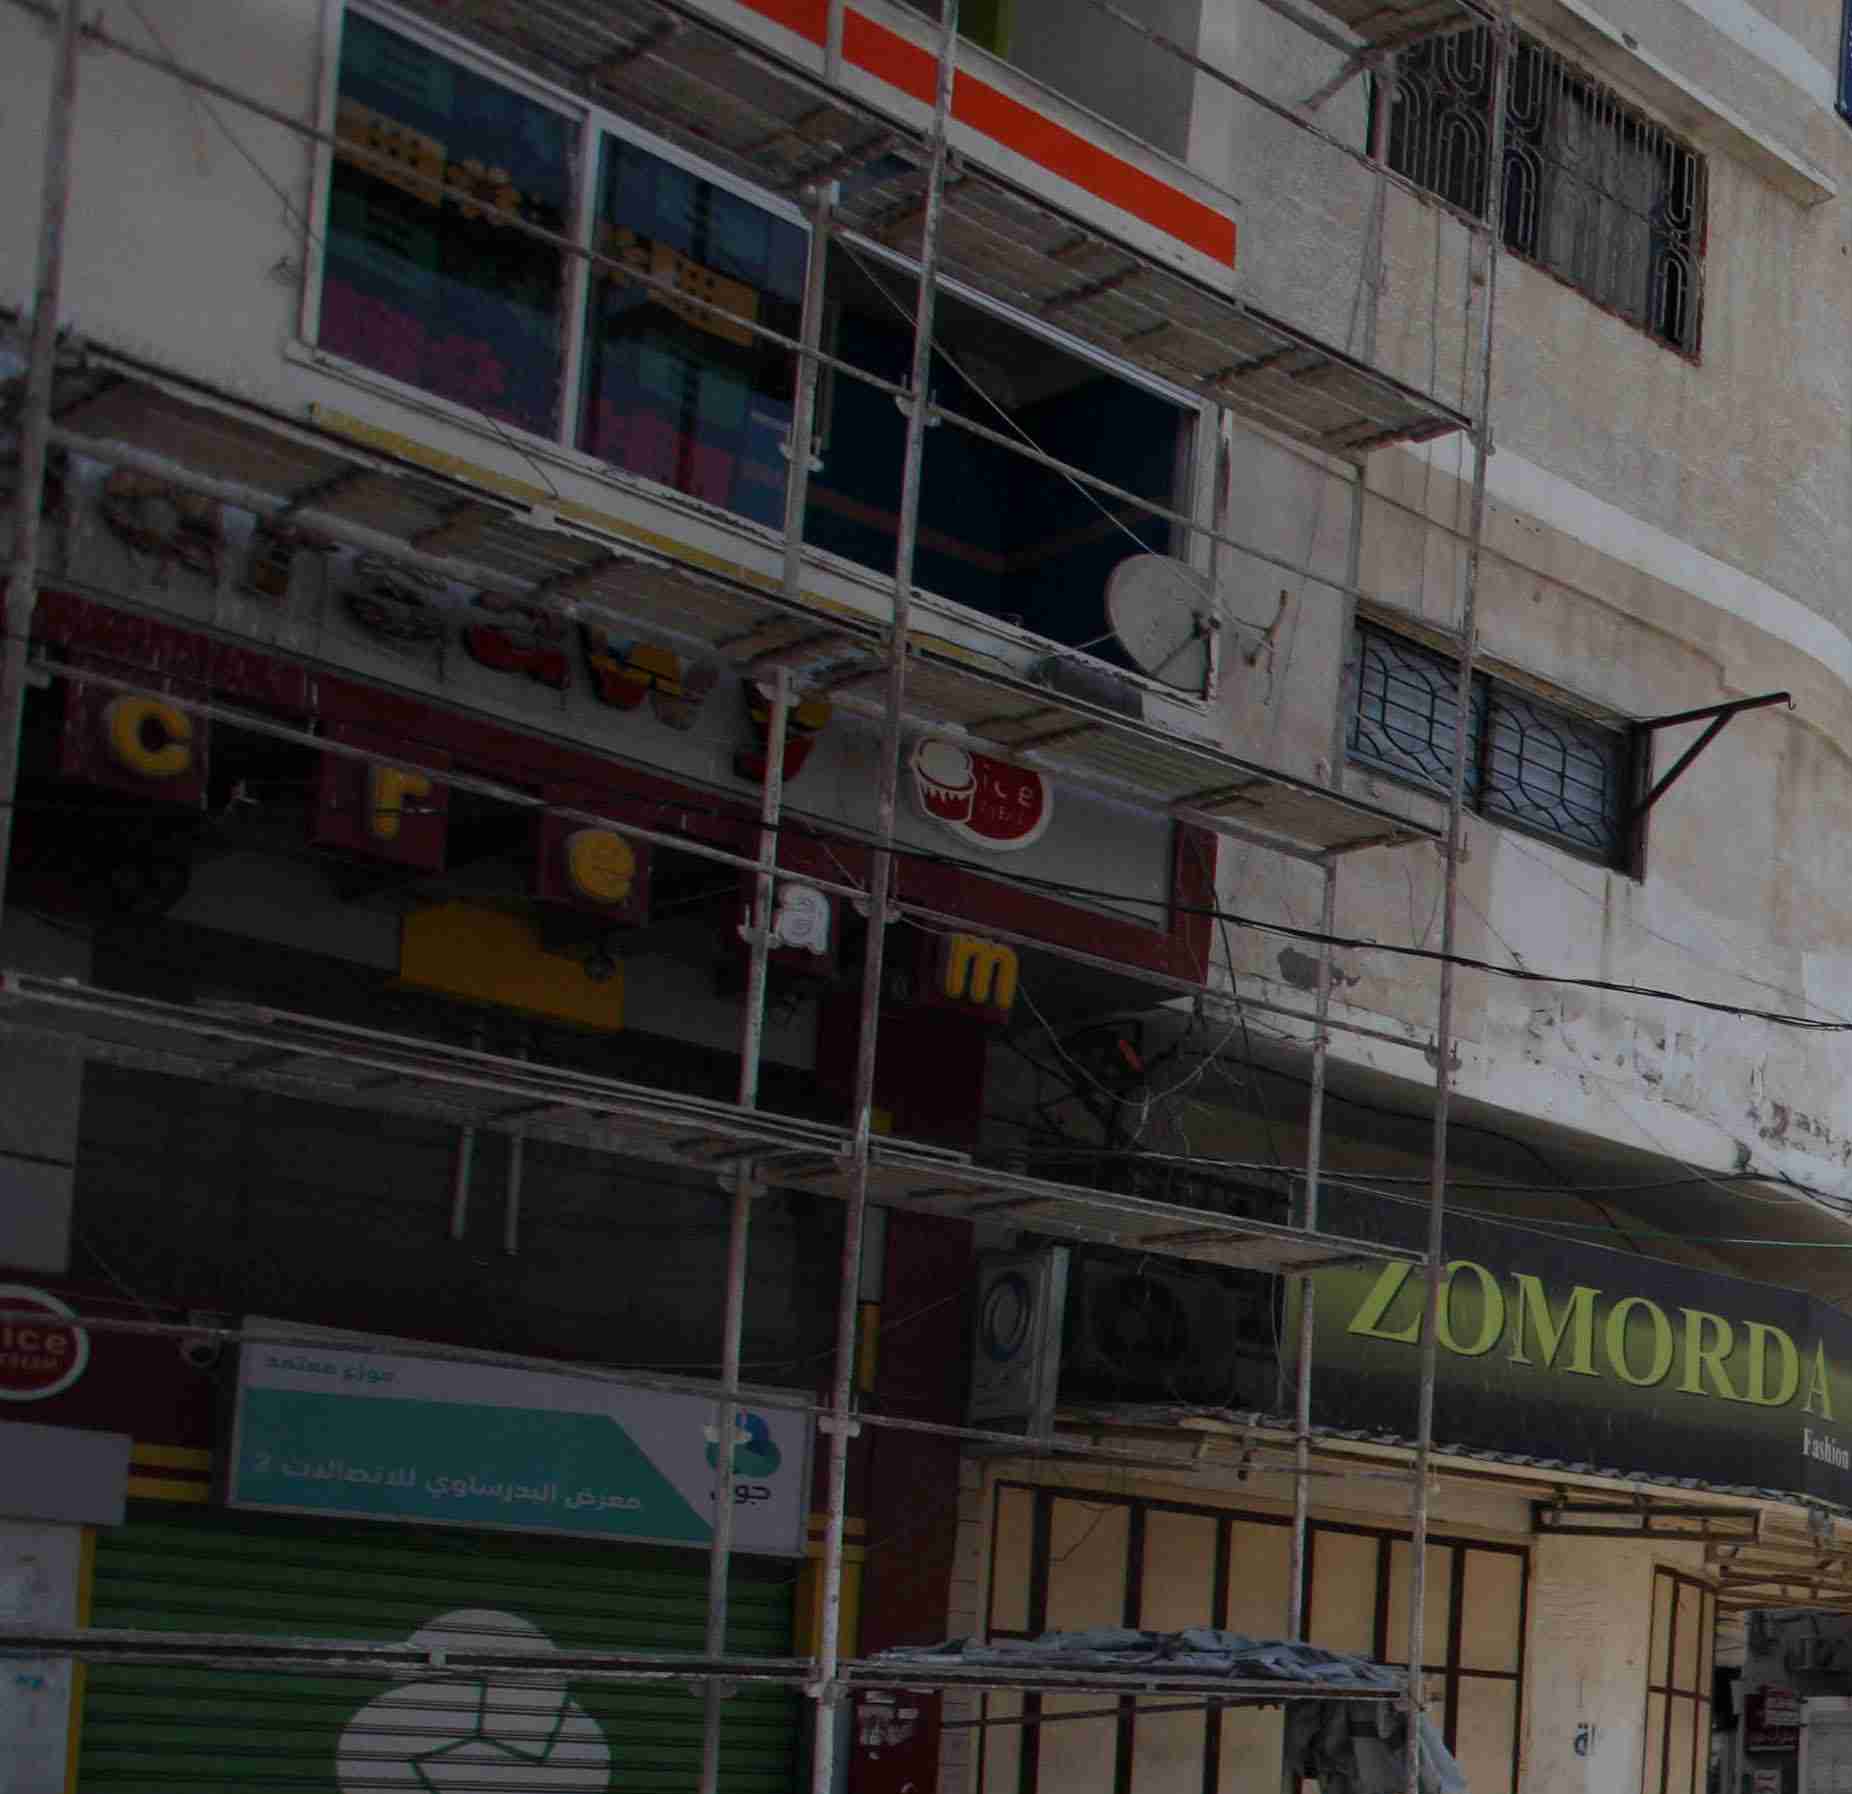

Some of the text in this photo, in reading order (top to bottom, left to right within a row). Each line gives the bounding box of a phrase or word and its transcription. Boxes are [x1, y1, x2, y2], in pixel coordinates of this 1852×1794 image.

[1347, 1258, 1837, 1424] ZOMORDA
[1803, 1426, 1850, 1470] Fashion
[562, 1485, 643, 1512] معرض
